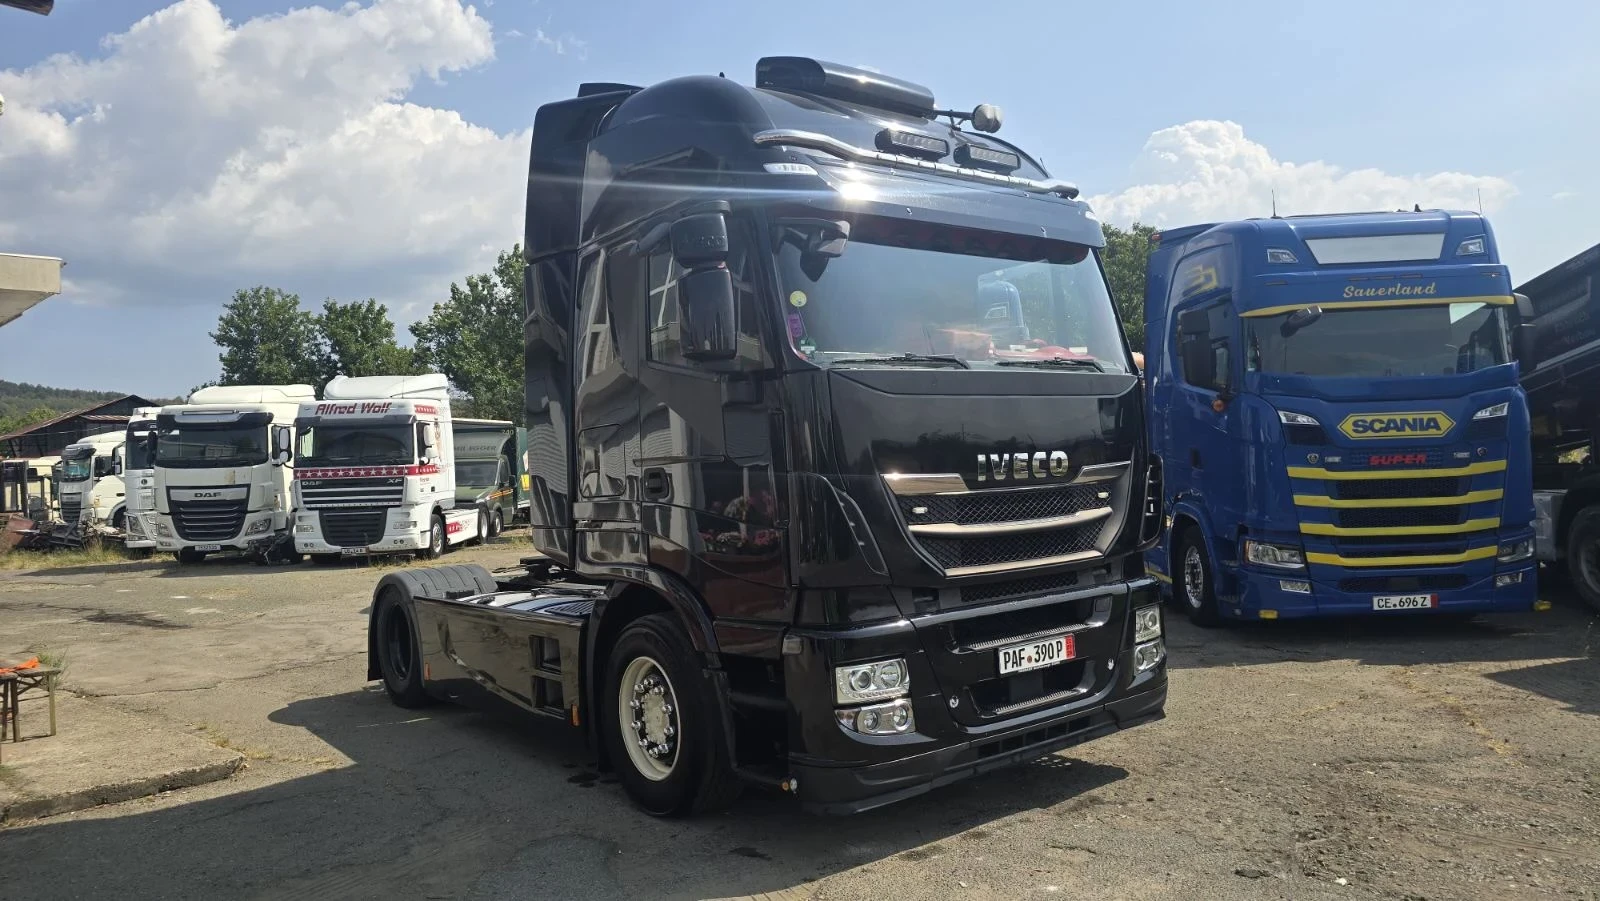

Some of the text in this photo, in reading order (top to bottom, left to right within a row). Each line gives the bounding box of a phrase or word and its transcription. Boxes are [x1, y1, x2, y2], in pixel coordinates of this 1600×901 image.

[1343, 282, 1437, 298] Sauerland
[315, 402, 392, 415] Alfred Wolf
[1352, 417, 1442, 434] SCANIA
[977, 450, 1069, 481] IVECO
[1369, 454, 1427, 466] SUPER
